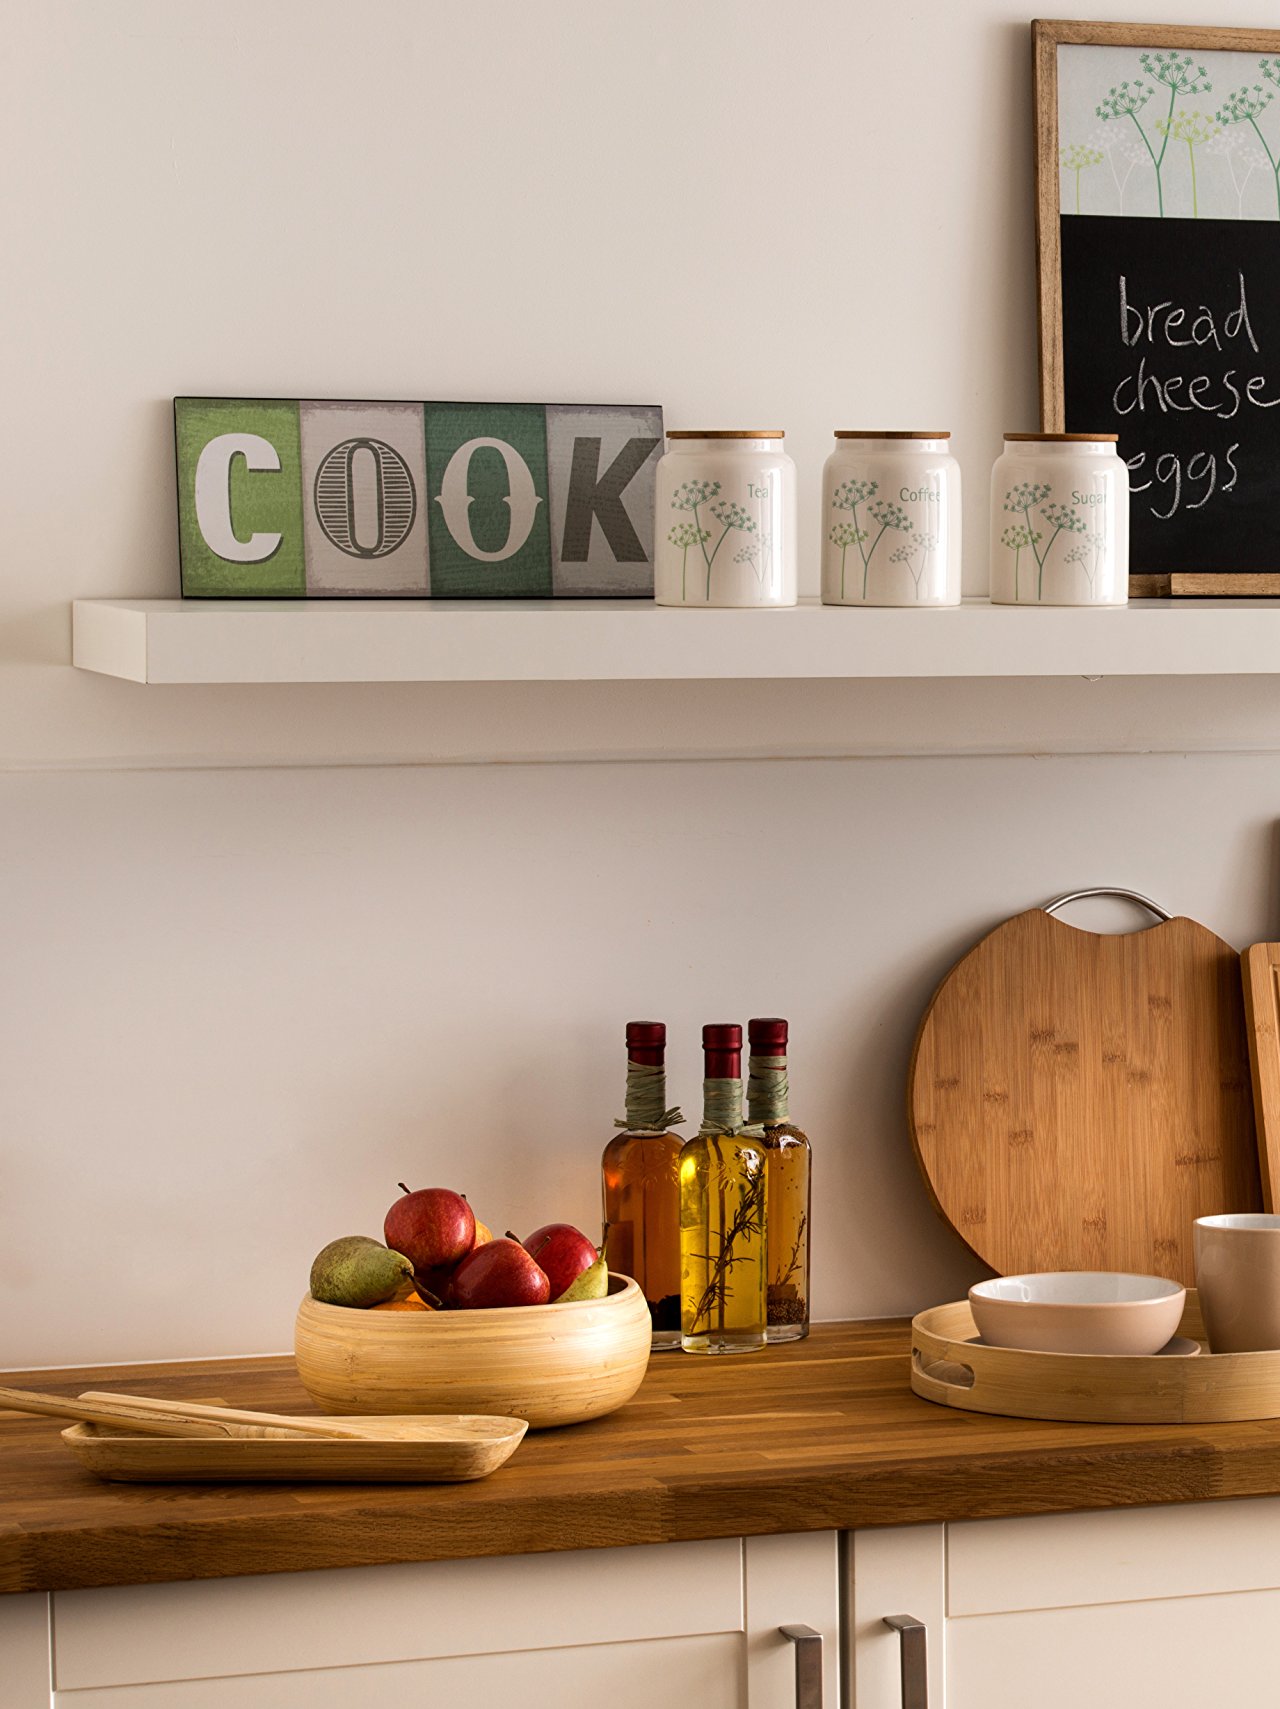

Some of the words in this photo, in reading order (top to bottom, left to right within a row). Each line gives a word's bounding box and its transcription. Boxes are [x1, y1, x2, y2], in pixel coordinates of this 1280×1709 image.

[1119, 269, 1260, 353] bread
[195, 432, 662, 565] COOK
[747, 483, 769, 499] Tea
[899, 487, 941, 502] Coffee
[1126, 442, 1240, 519] eggs
